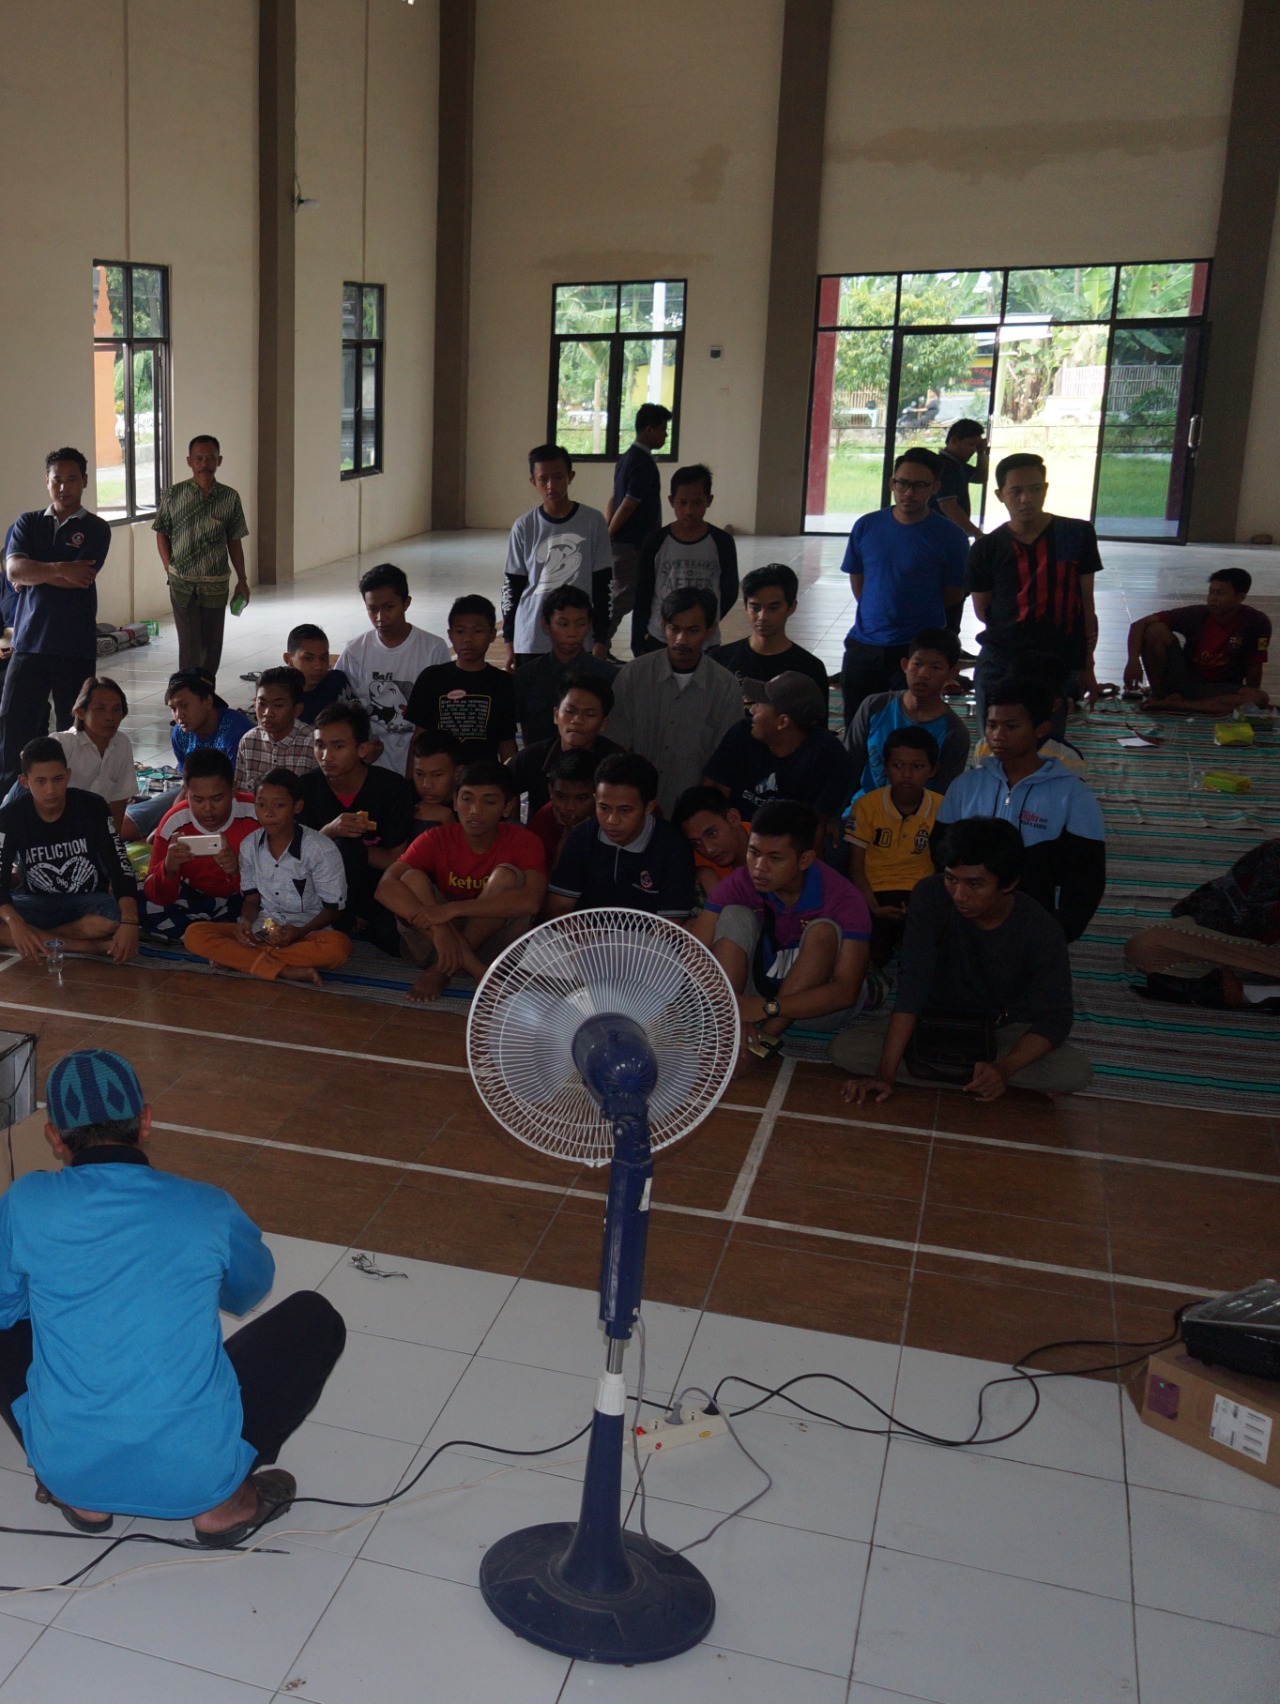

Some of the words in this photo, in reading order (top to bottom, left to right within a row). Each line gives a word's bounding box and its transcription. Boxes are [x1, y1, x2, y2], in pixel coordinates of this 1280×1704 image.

[372, 671, 393, 681] Bali
[872, 827, 893, 849] 10
[25, 837, 88, 865] AFFLICTION
